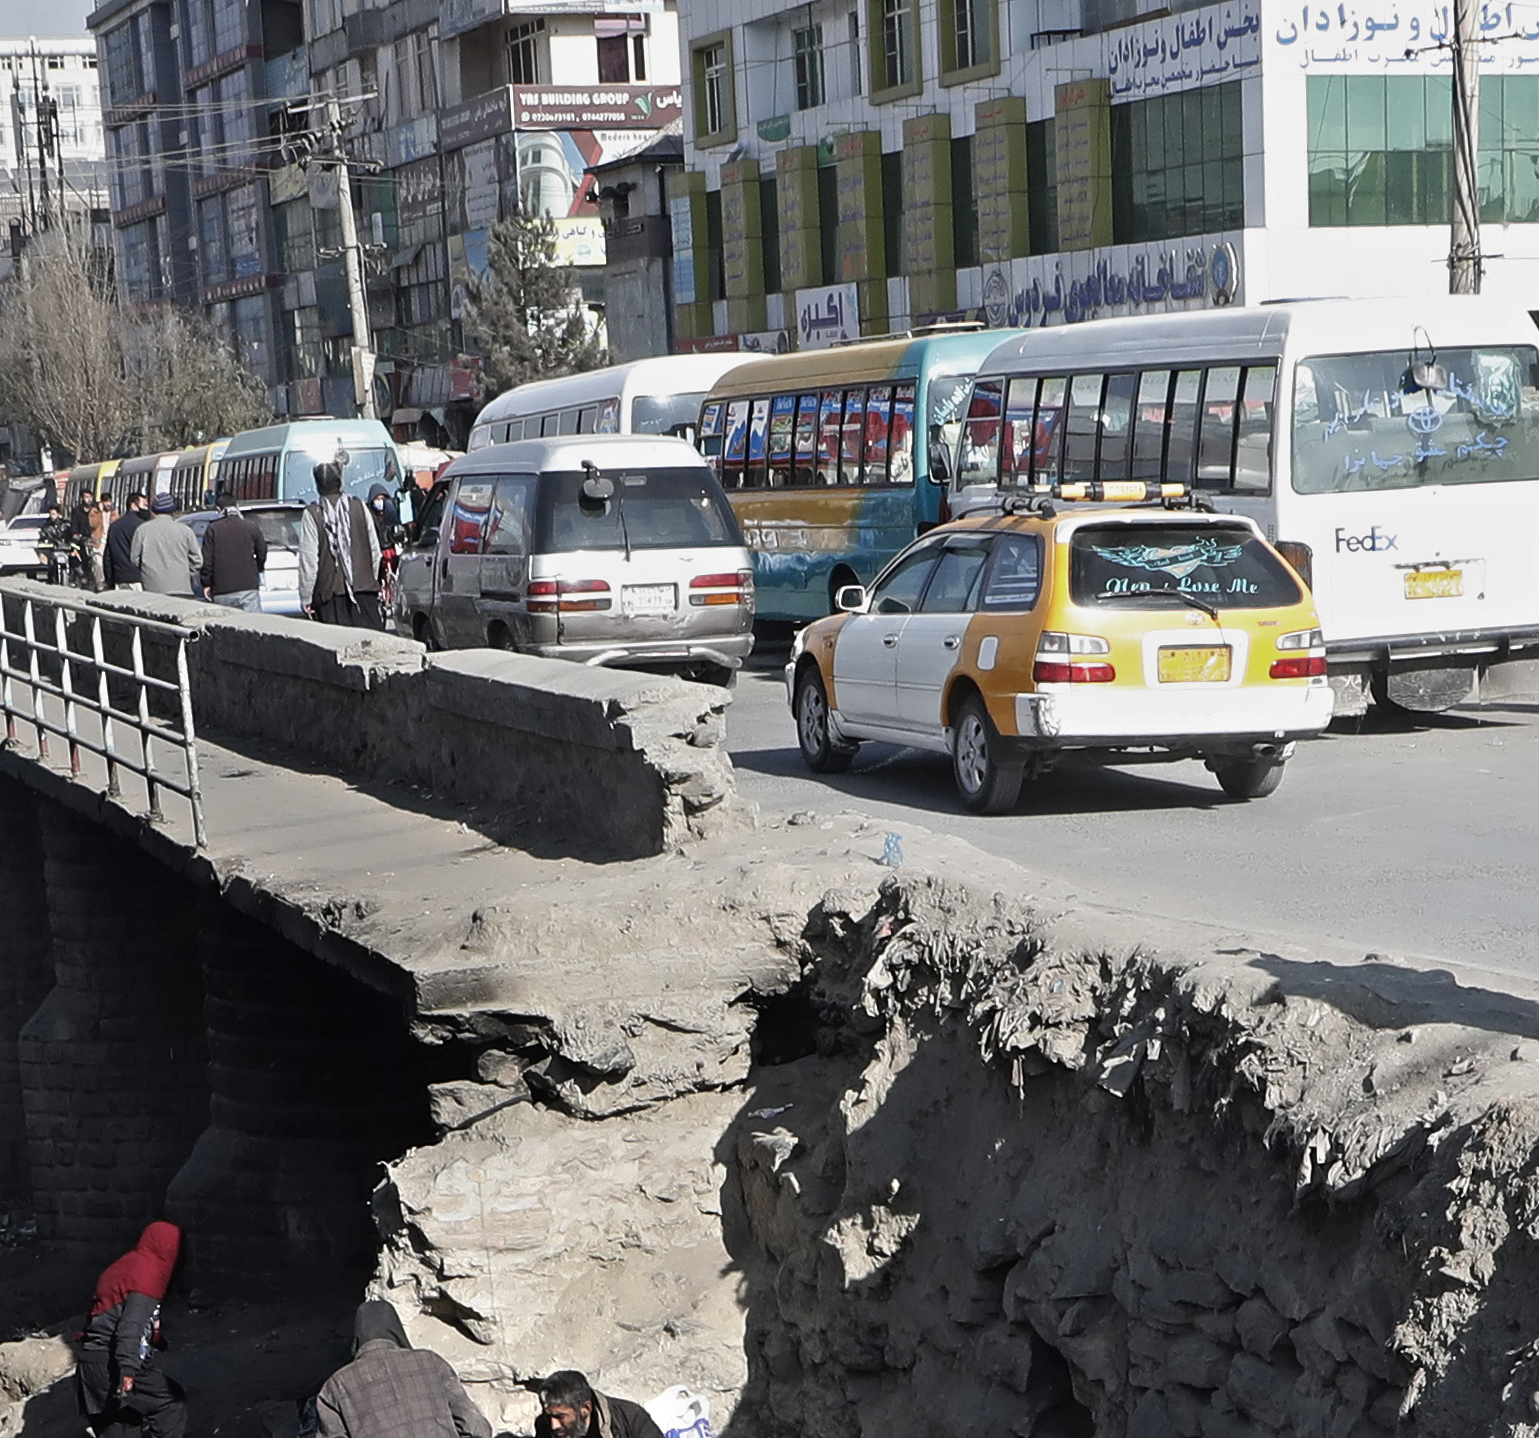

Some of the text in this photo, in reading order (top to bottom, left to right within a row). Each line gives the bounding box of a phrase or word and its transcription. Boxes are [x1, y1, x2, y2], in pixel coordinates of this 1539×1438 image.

[1169, 15, 1212, 60] اطفال
[1217, 4, 1259, 51] بخش
[1276, 2, 1399, 45] نوزادان
[1409, 16, 1420, 41] و
[1430, 2, 1512, 45] اطل
[520, 93, 629, 105] YAS BUILDING GROUP
[1009, 260, 1064, 327] فردوس
[1335, 525, 1399, 553] FedEx
[1176, 577, 1221, 593] Lose
[1227, 578, 1259, 594] Me
